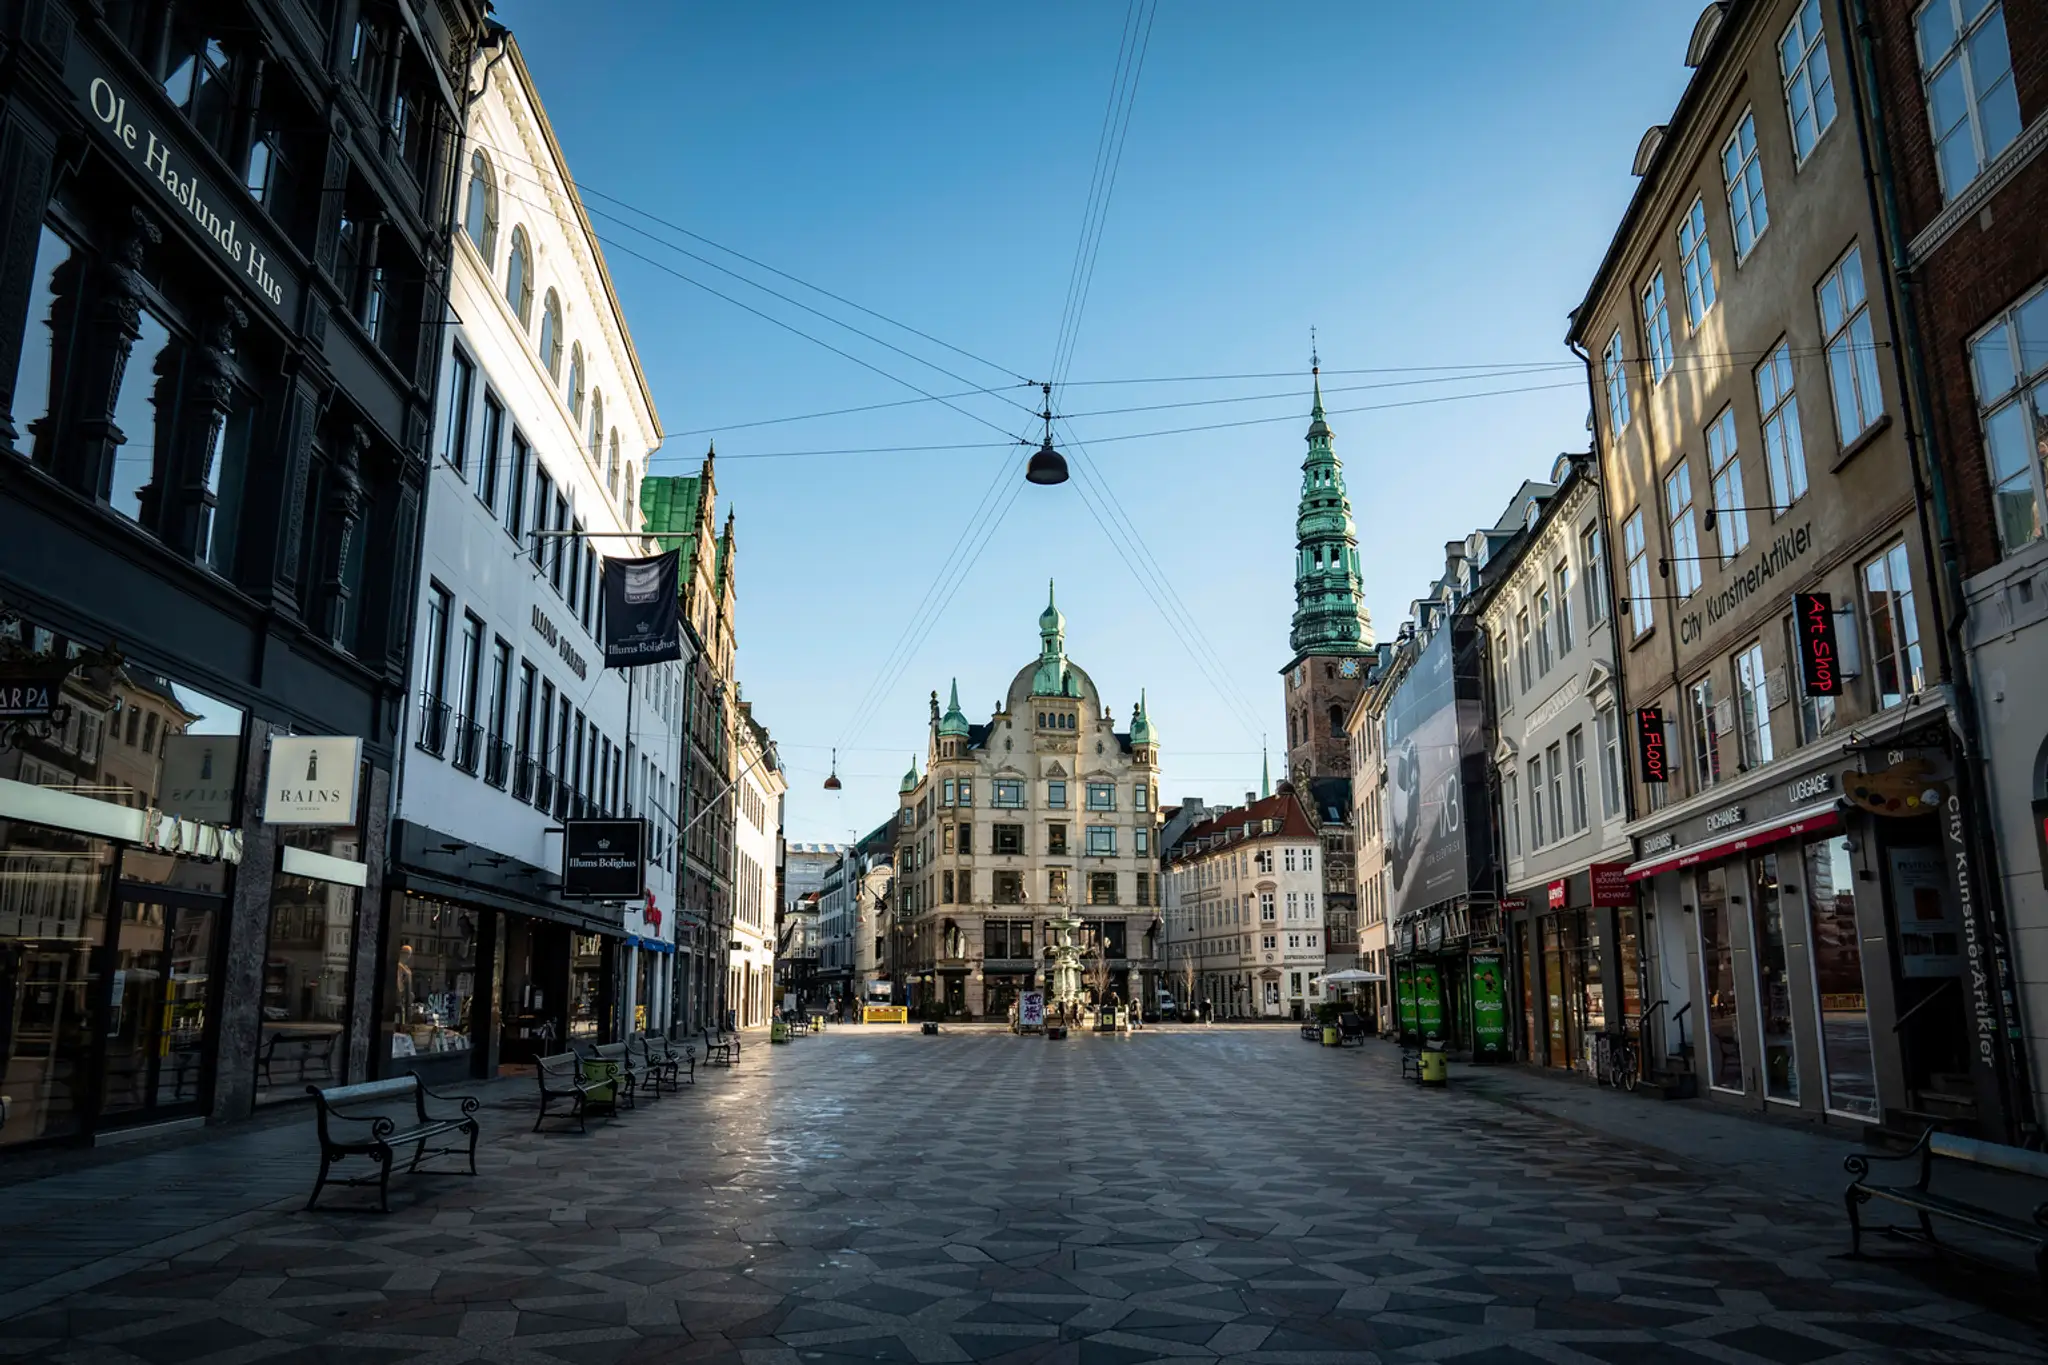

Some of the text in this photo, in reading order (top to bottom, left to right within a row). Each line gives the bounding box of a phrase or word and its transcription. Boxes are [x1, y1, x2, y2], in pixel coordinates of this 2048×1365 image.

[90, 77, 284, 306] Ole Haslunds Hus
[1681, 521, 1812, 645] City KunstnerArtikler
[609, 639, 676, 655] Illums Bolighus
[1808, 595, 1834, 692] Art Shop
[279, 789, 340, 803] RAINS
[1788, 773, 1830, 803] LUGGAGE
[1706, 806, 1742, 831] EXCHANGE
[569, 857, 637, 870] Illums Bolighus
[1947, 794, 1996, 1069] City KunstnerArtikler
[428, 992, 449, 1013] SALE
